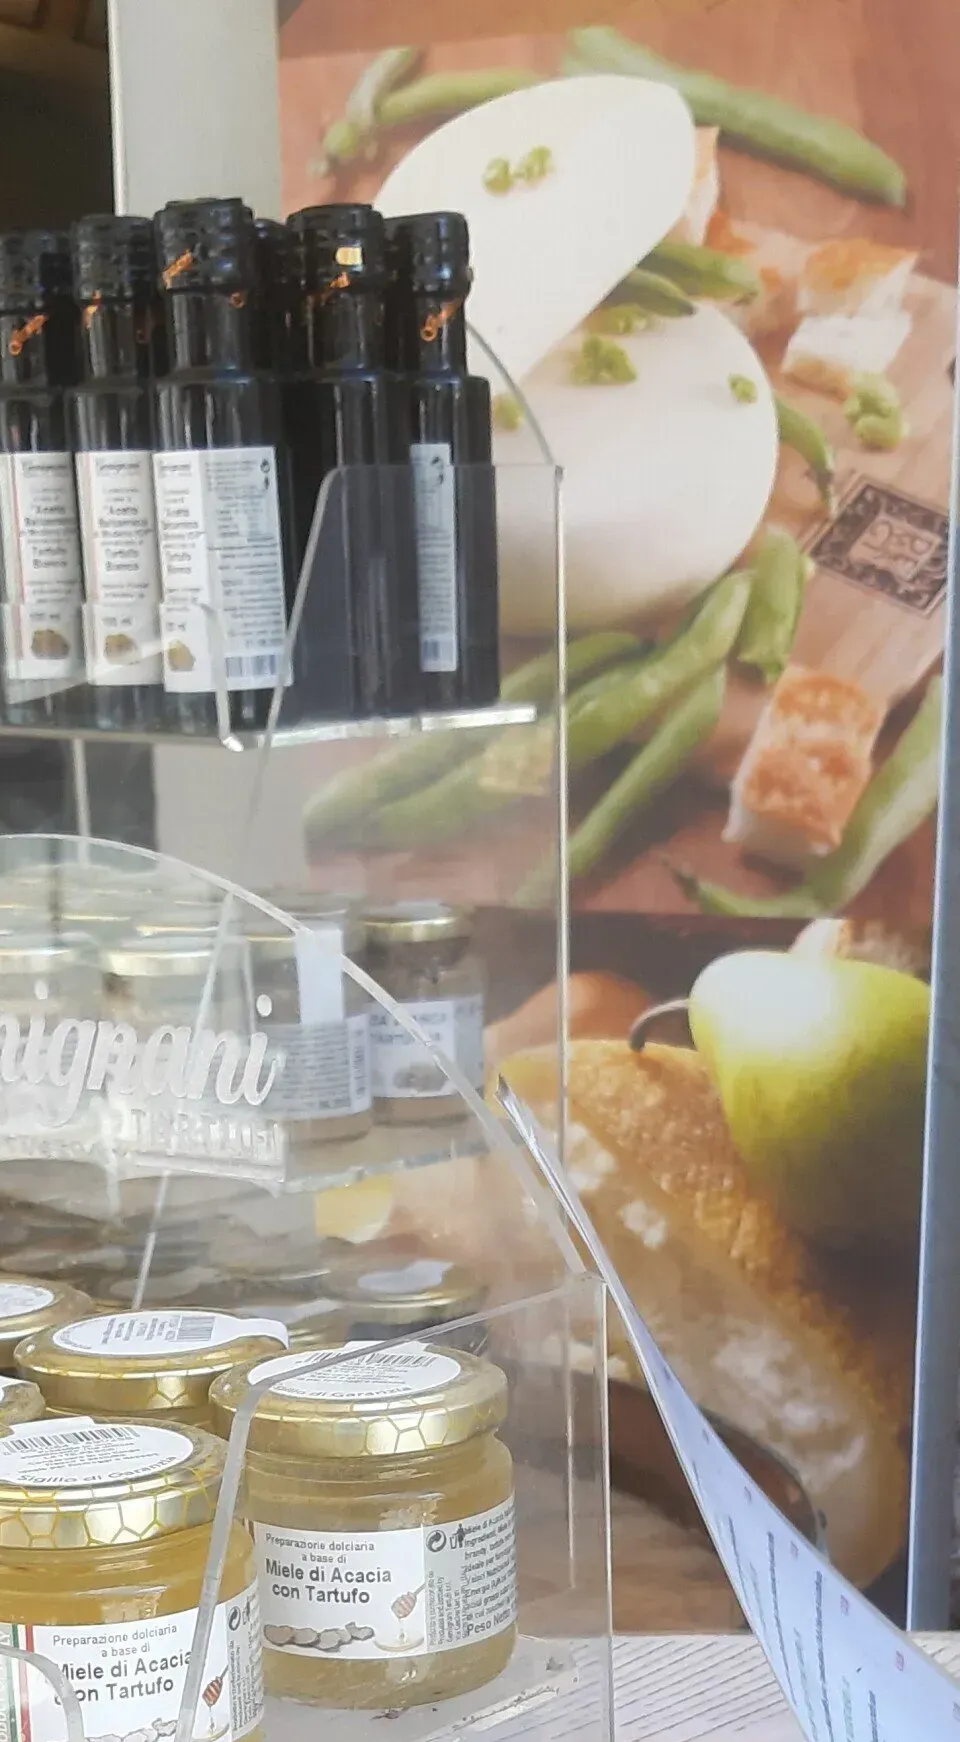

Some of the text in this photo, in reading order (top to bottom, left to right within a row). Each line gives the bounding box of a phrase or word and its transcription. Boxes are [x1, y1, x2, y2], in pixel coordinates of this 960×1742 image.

[331, 1385, 413, 1398] Garanzia
[16, 1456, 178, 1485] Sigillo di Garanzia
[265, 1532, 375, 1551] Preparazione dolciaria
[310, 1553, 347, 1564] base di
[265, 1558, 393, 1583] Miele di Acacia
[271, 1583, 371, 1604] con Tartufo
[52, 1623, 178, 1647] Preparazione dolciaria
[467, 1620, 492, 1637] Peso
[111, 1645, 140, 1658] base
[141, 1642, 151, 1654] di
[110, 1649, 193, 1676] di Acacia
[105, 1676, 175, 1702] Tartufo
